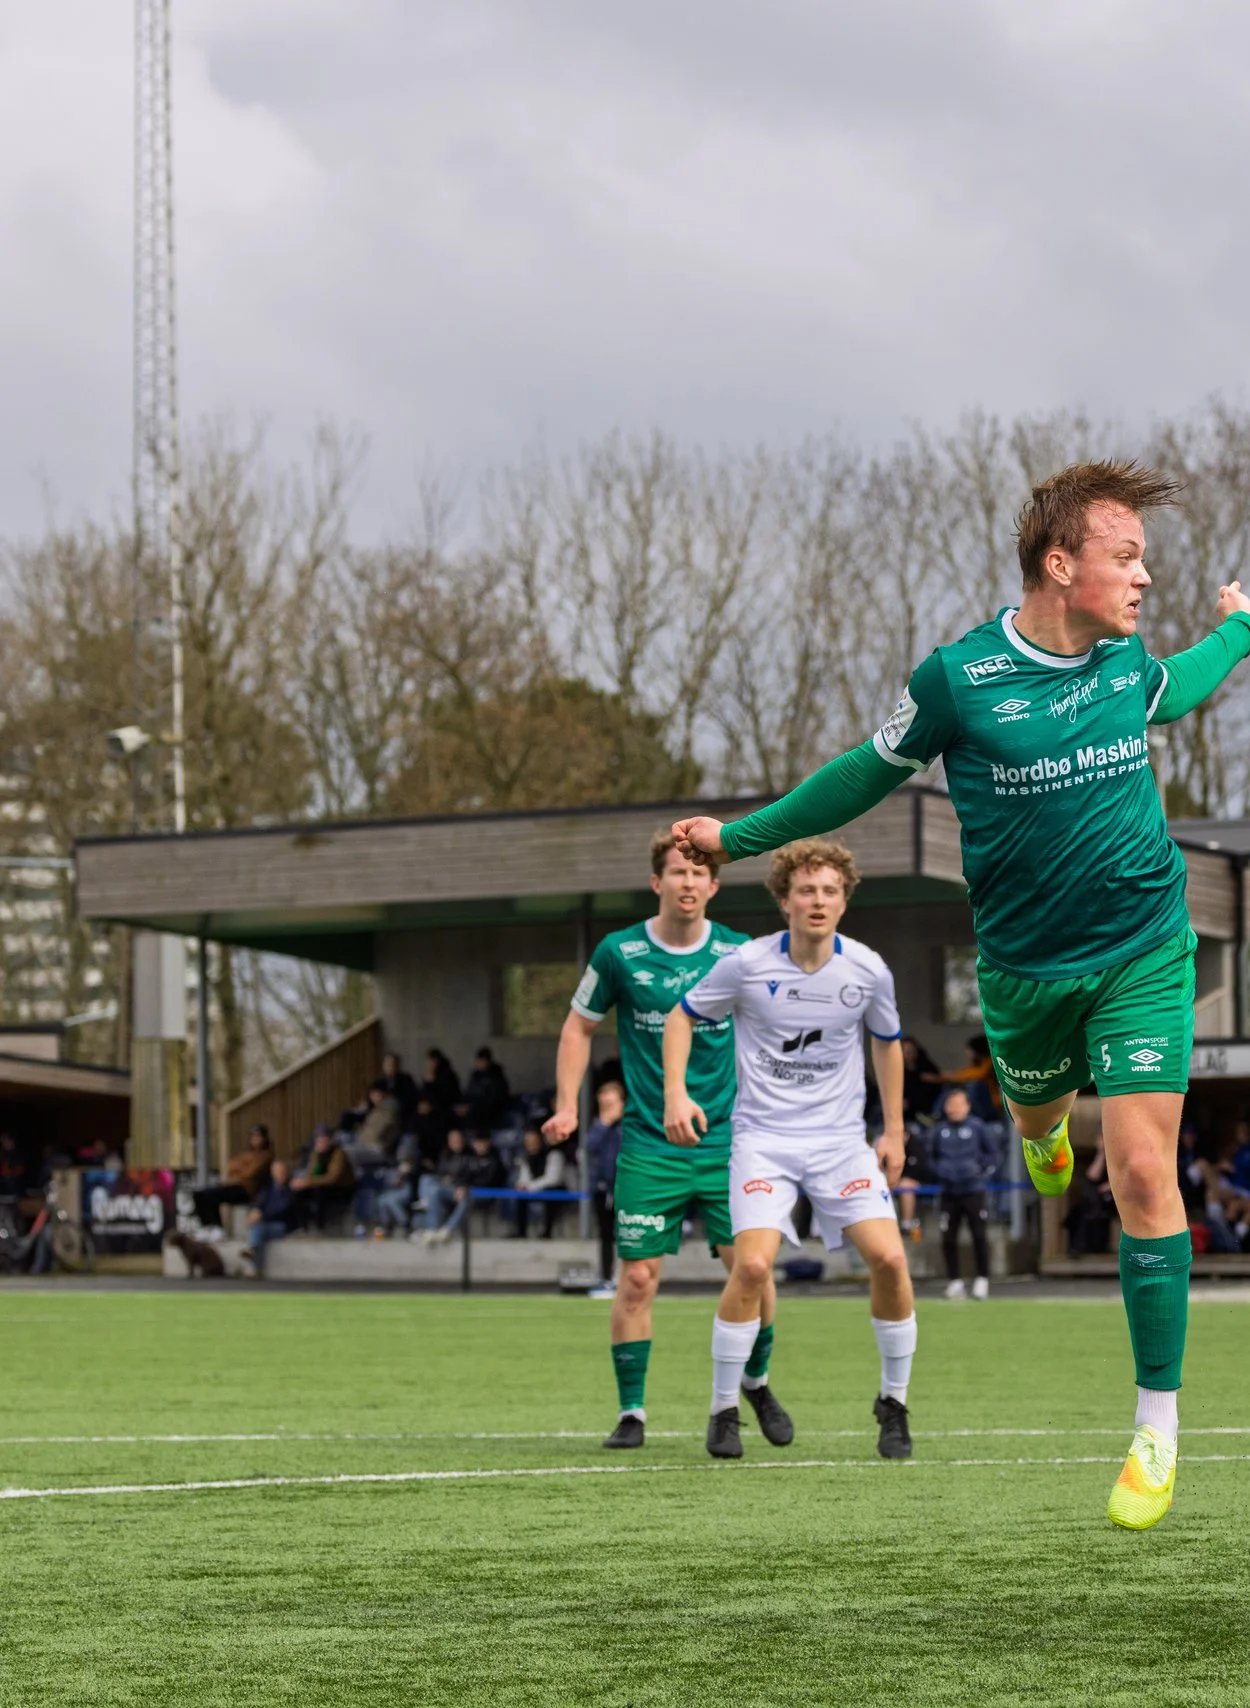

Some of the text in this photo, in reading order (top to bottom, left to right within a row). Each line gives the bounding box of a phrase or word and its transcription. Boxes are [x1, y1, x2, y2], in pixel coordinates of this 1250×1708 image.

[969, 657, 1010, 678] NSE
[998, 713, 1030, 723] umbro
[991, 756, 1072, 783] Nordbø
[1076, 735, 1142, 770] Maskin
[1101, 1044, 1112, 1072] 5
[772, 1068, 814, 1084] Norge
